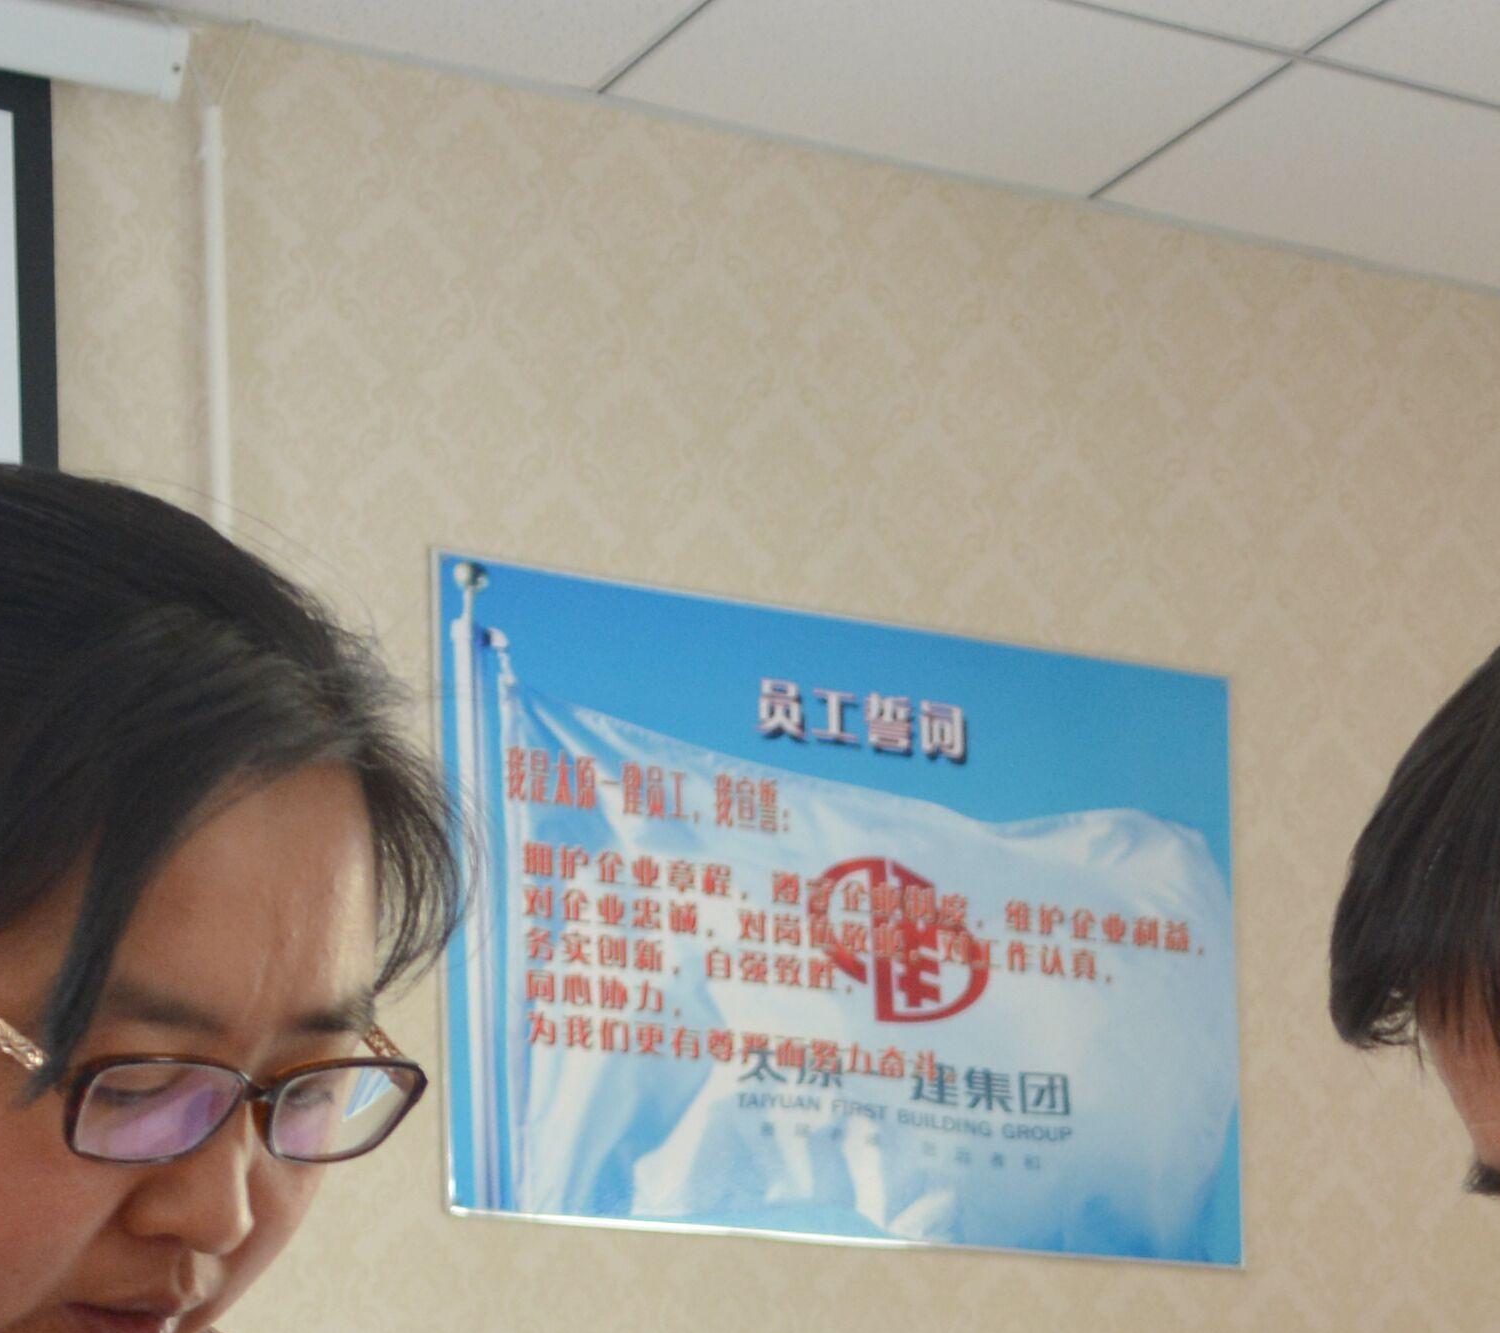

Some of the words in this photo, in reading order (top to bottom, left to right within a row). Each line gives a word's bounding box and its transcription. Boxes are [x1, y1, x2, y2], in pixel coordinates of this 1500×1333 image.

[757, 678, 967, 759] 员工誓词
[738, 1091, 820, 1112] TAIYUAN
[832, 1100, 887, 1121] FIRST
[897, 1110, 993, 1138] BUILDING
[1002, 1122, 1074, 1142] GROUP
